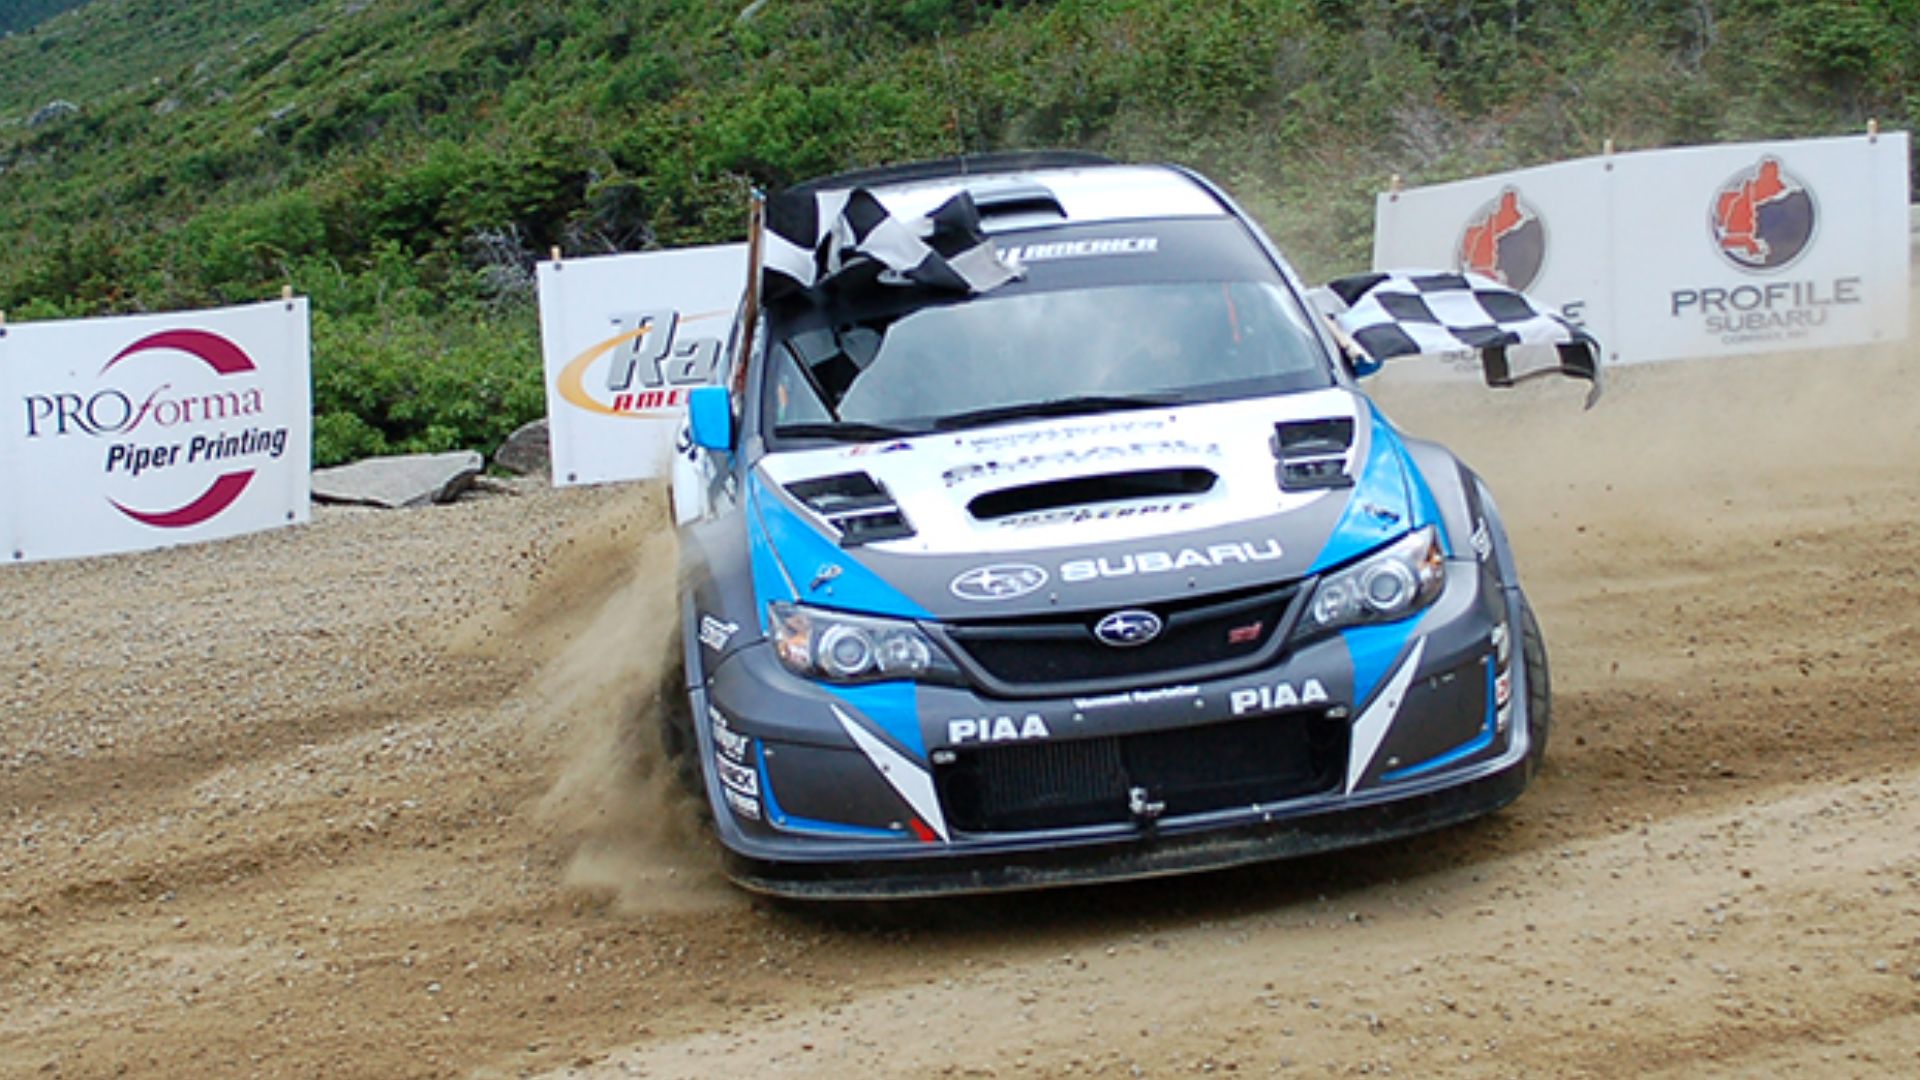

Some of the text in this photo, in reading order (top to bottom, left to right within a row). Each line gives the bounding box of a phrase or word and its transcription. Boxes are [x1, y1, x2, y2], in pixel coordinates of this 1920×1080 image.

[1670, 276, 1861, 317] PROFILE
[1705, 308, 1828, 335] SUBARU
[105, 426, 288, 476] Piper Printing
[1060, 539, 1282, 583] SUBARU
[1230, 678, 1329, 715] PIAA
[948, 713, 1050, 745] PIAA
